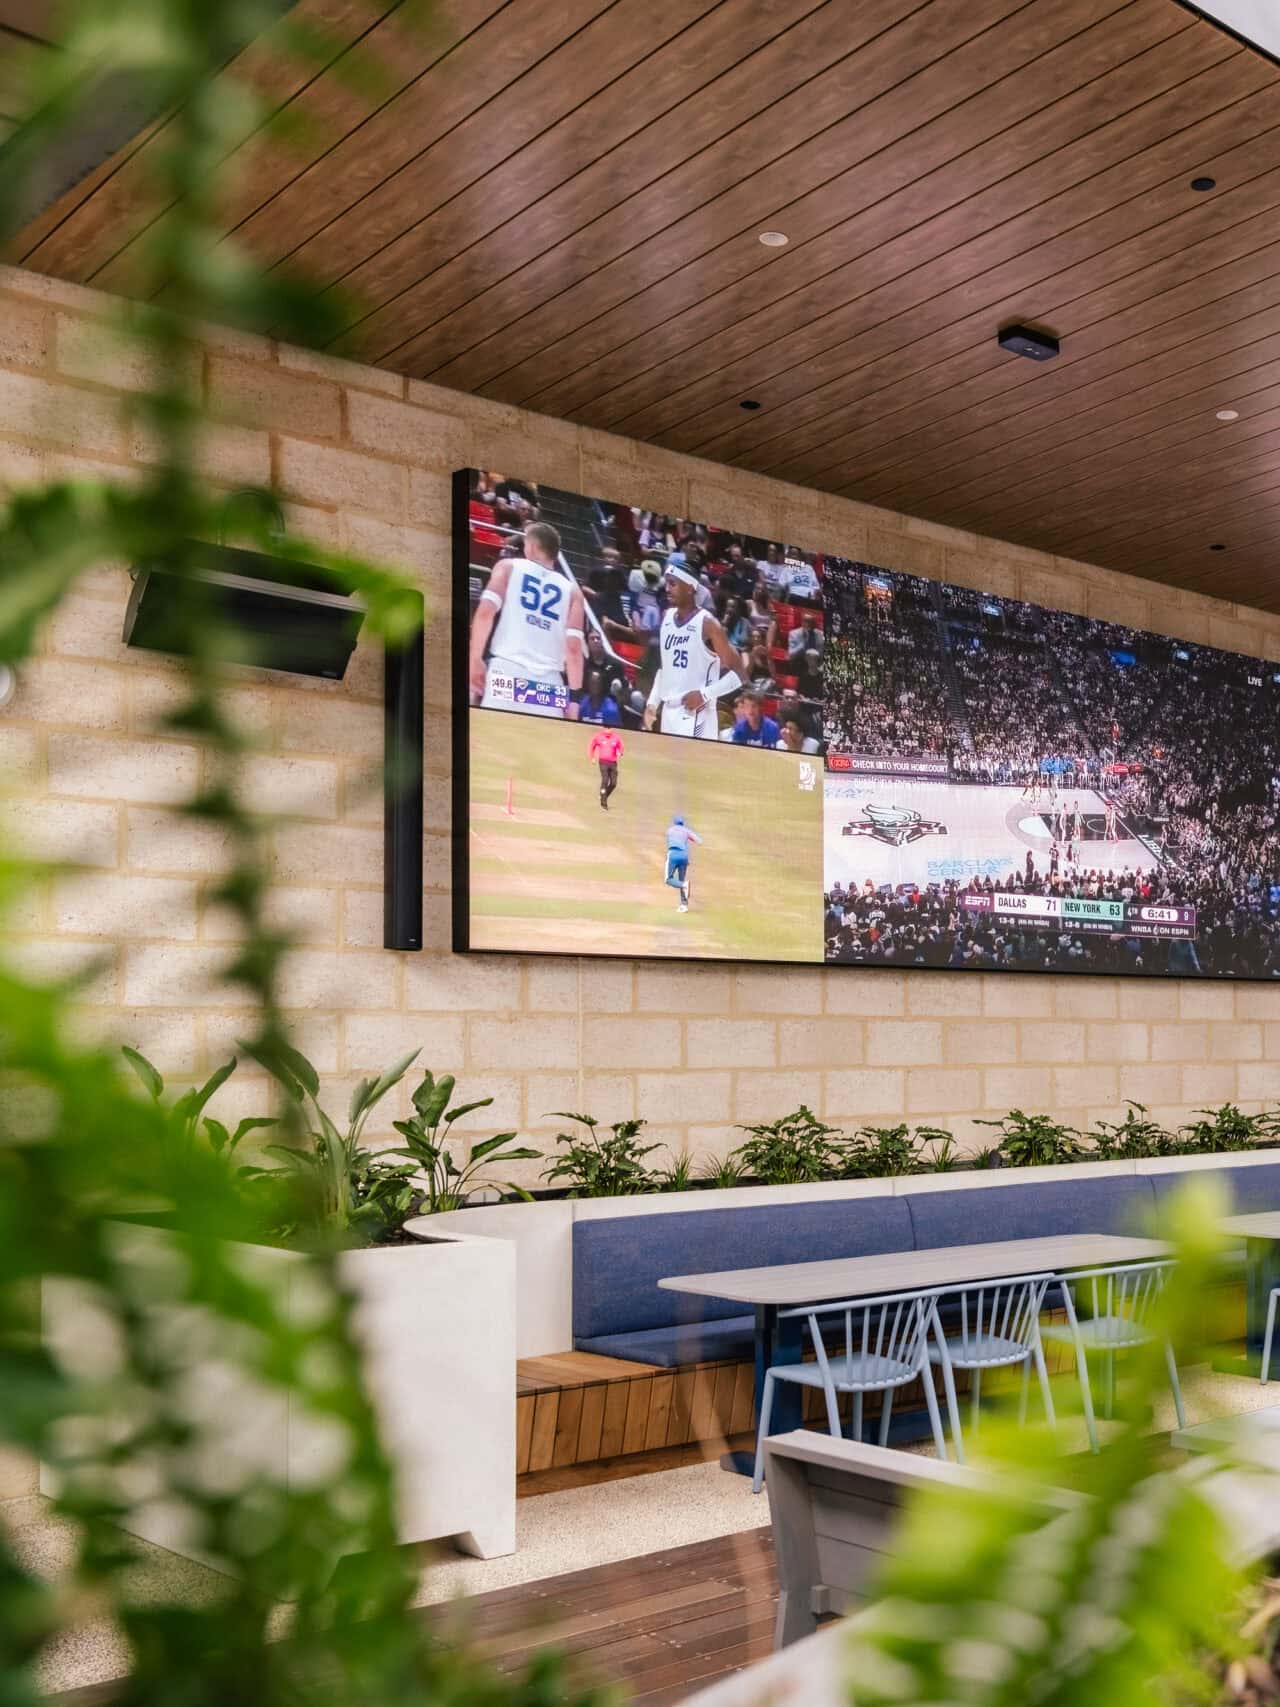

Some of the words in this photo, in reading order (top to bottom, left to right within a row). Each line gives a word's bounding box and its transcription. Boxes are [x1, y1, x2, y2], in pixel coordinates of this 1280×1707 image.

[520, 574, 562, 621] 52
[664, 634, 690, 650] UTAH
[672, 649, 689, 668] 25
[554, 686, 567, 697] 33
[554, 697, 567, 708] 53
[852, 759, 875, 769] CHECK
[893, 762, 909, 771] YOUR
[964, 895, 991, 907] ESPN
[998, 897, 1027, 908] DALLAS
[1045, 899, 1057, 911] 71
[1064, 902, 1080, 913] NEW
[1082, 903, 1101, 914] YORK
[1109, 904, 1120, 916] 63
[1147, 909, 1171, 920] 6:41
[1171, 928, 1189, 936] ESPN
